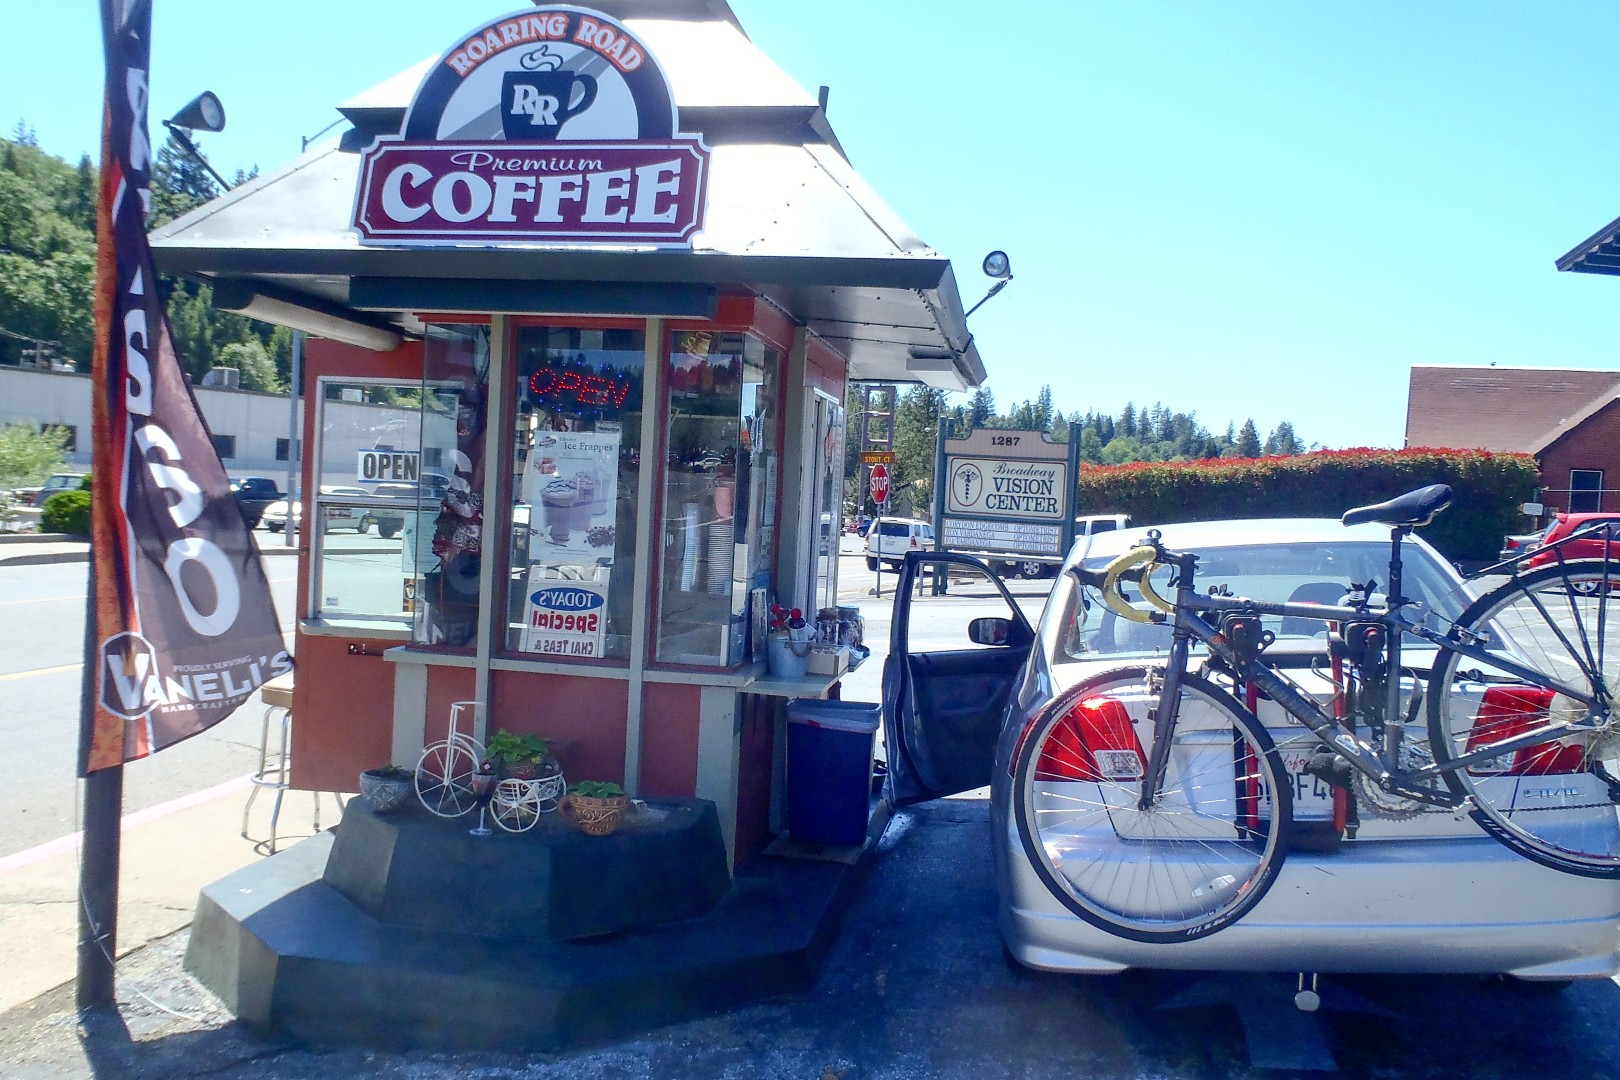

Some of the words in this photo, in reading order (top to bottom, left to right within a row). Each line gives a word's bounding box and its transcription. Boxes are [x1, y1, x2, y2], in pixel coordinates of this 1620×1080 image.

[447, 15, 567, 76] ROARING
[576, 18, 643, 72] ROAD
[511, 84, 558, 126] RR
[451, 151, 604, 172] Premium
[381, 158, 682, 224] COFFEE
[530, 368, 629, 409] OPEN
[564, 441, 577, 450] Ice
[580, 442, 613, 453] Frappes
[991, 436, 1020, 446] 1287
[362, 453, 418, 480] OPEN
[993, 462, 1056, 480] Broadway
[871, 477, 889, 491] STOP
[992, 477, 1054, 496] VISION
[985, 493, 1059, 514] CENTER
[173, 664, 212, 673] PROUDLY
[213, 655, 252, 669] SERVING
[107, 650, 293, 710] VANELI'S
[1524, 787, 1587, 798] CIVIC
